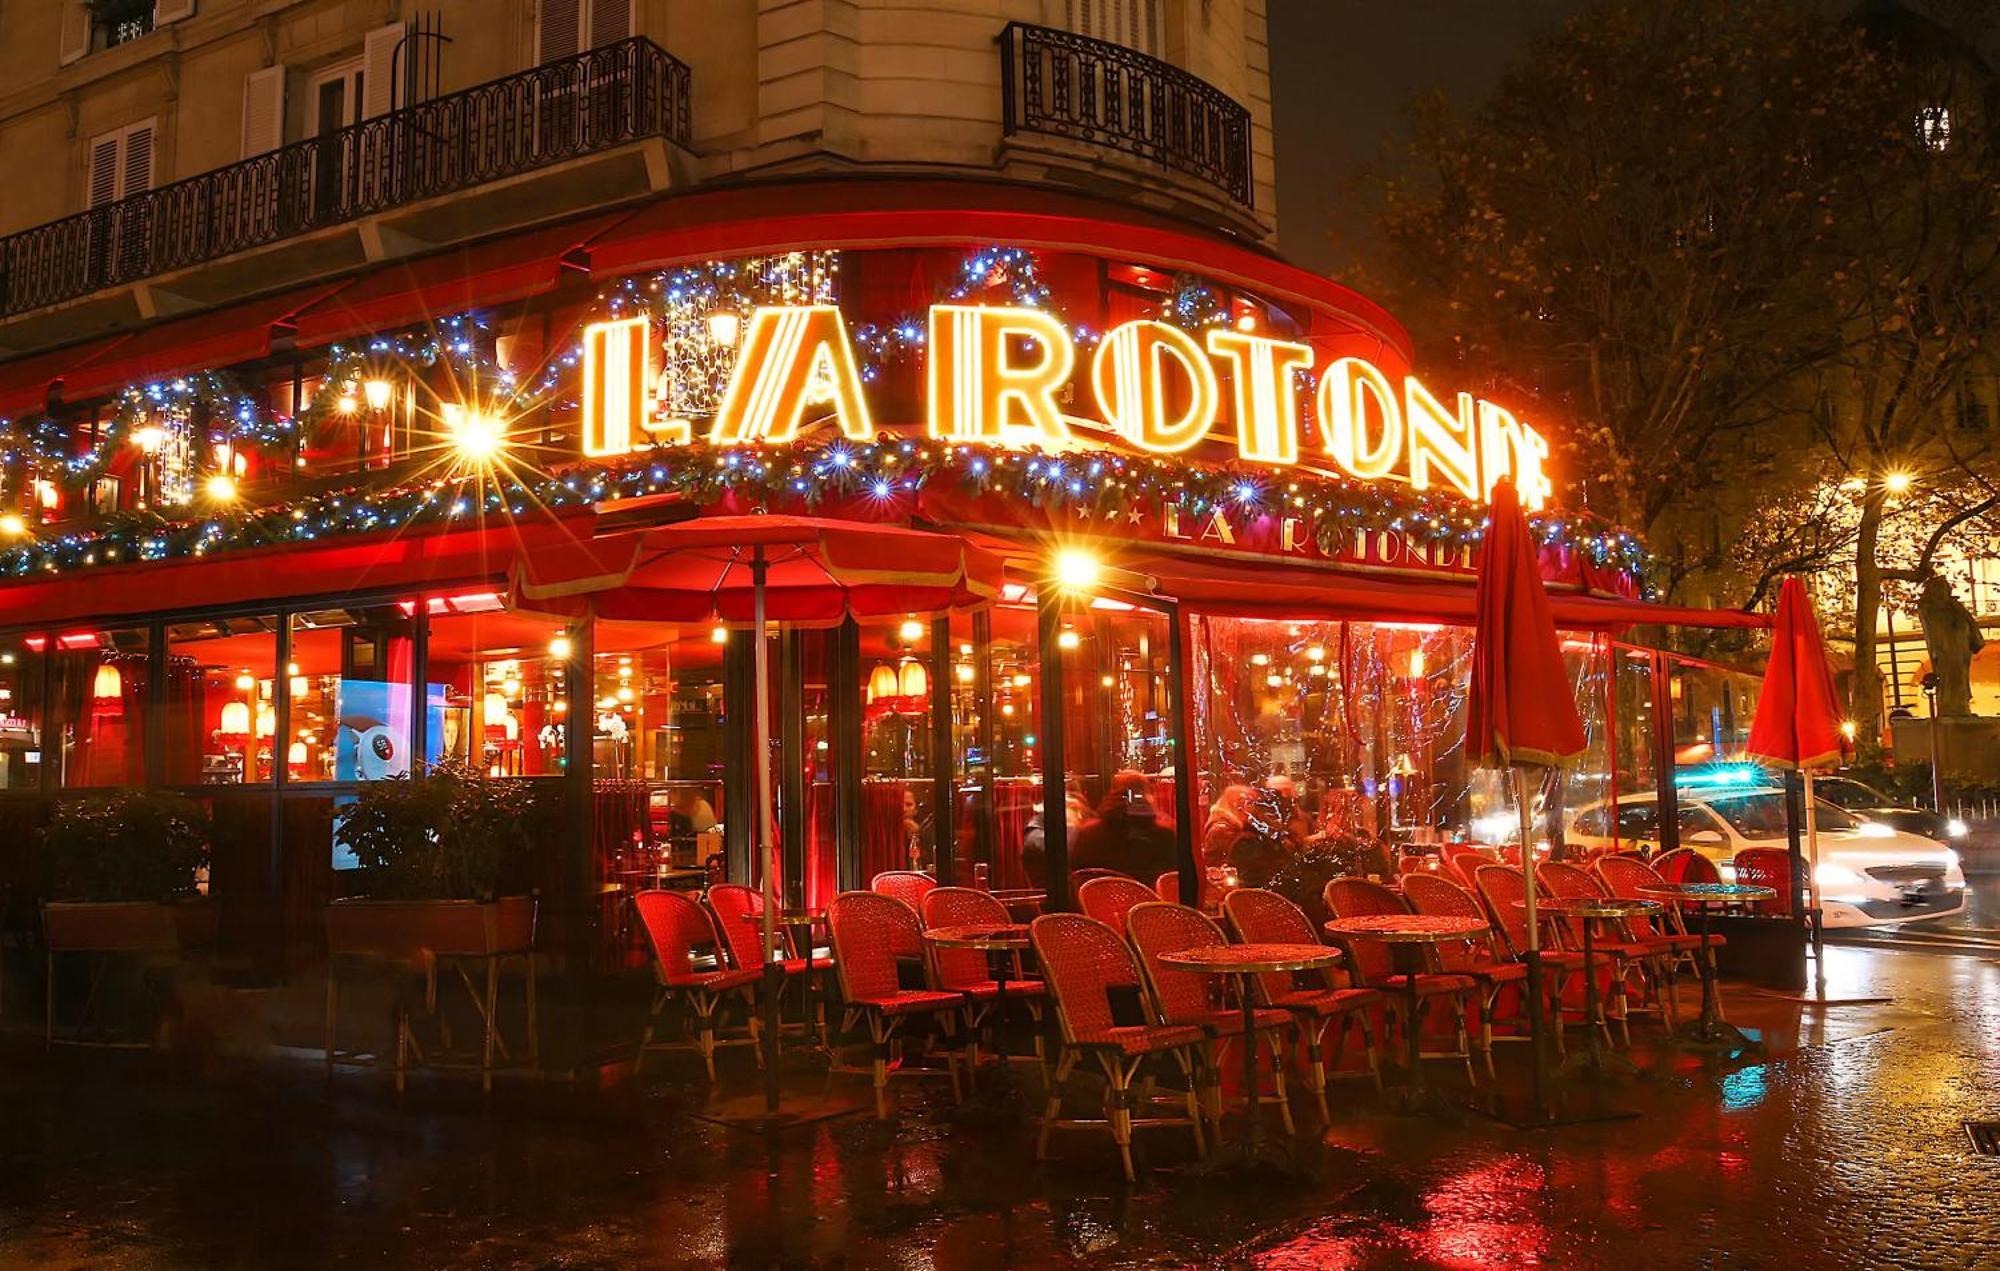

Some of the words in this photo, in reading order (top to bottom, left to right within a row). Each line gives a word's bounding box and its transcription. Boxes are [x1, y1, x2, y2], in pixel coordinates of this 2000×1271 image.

[584, 305, 874, 457] LA
[928, 305, 1552, 512] ROTONDE
[1163, 501, 1236, 544] LA
